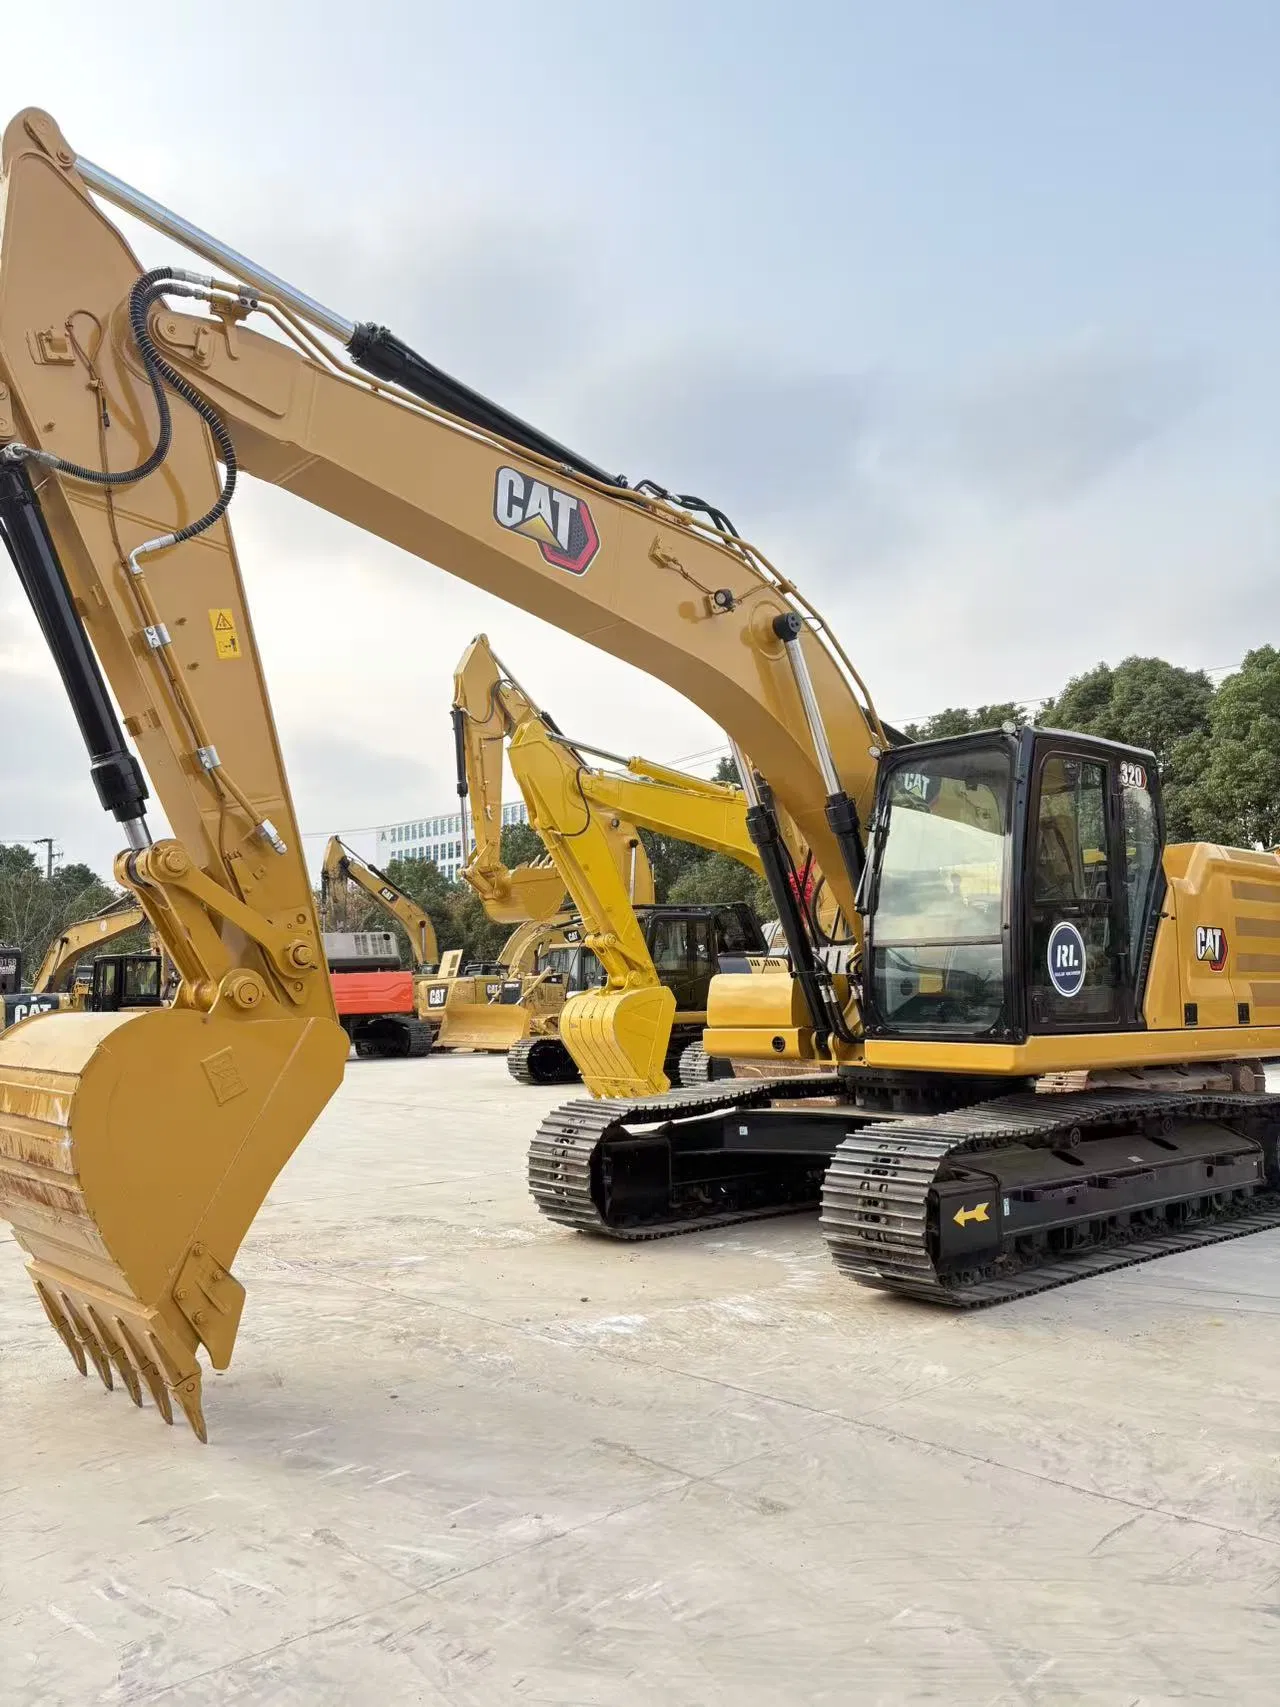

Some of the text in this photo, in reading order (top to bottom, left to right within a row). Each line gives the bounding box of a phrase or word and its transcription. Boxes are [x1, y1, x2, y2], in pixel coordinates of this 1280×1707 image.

[496, 467, 578, 550] CAT
[904, 773, 930, 800] CAT
[1120, 762, 1143, 788] 320
[381, 888, 394, 901] CAT
[567, 930, 579, 942] CAT
[1196, 926, 1222, 961] CAT
[429, 989, 446, 1005] CAT
